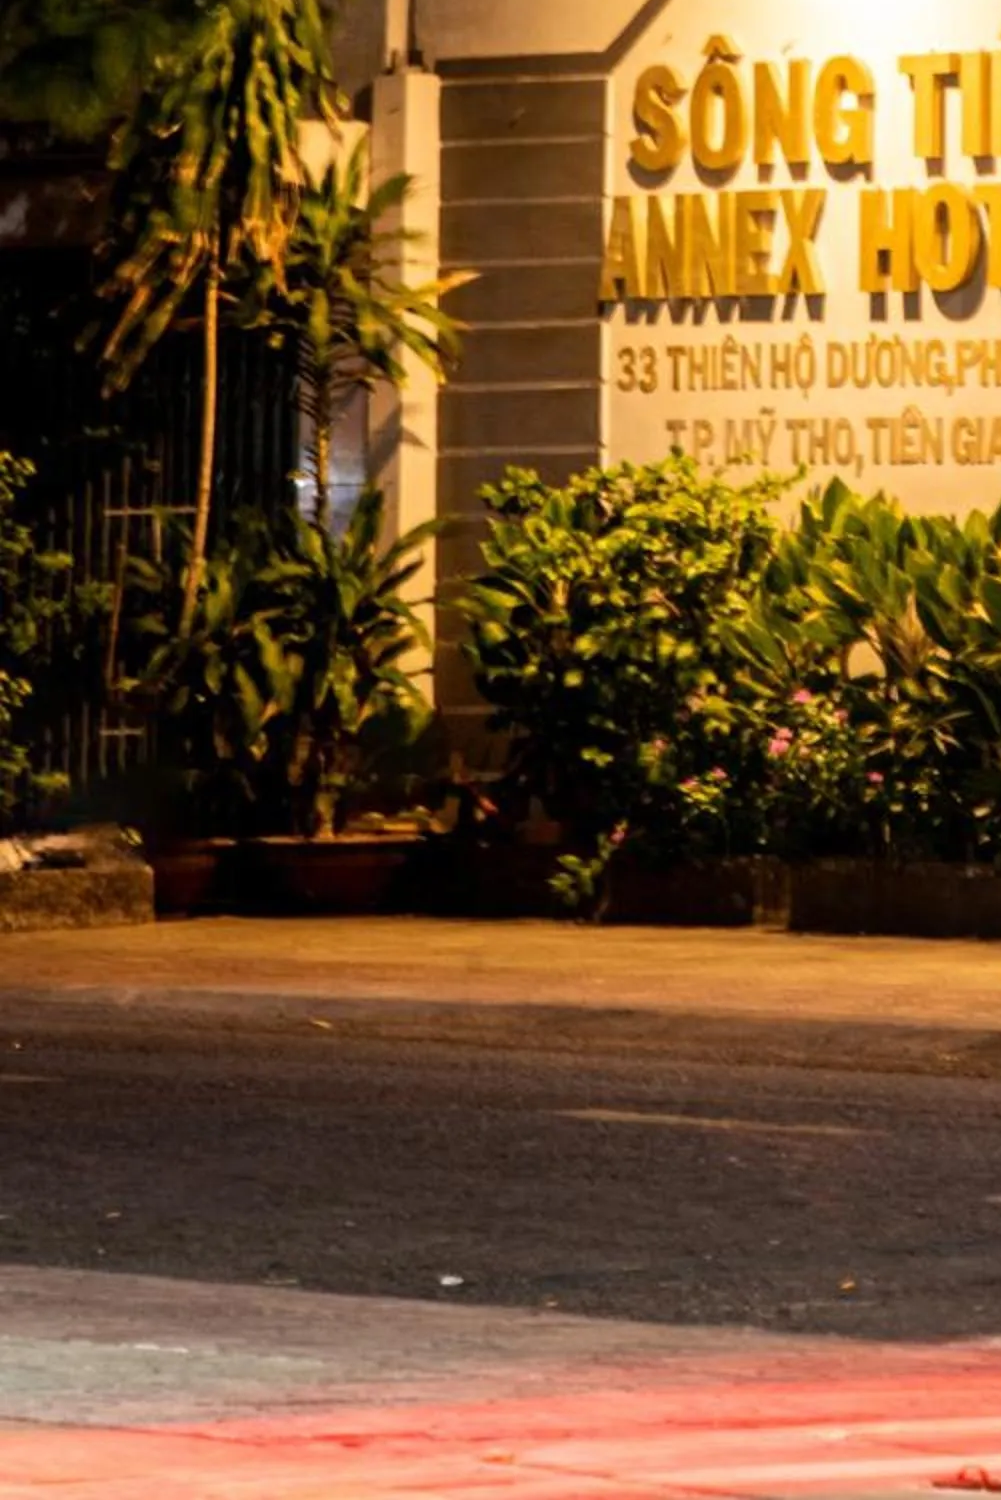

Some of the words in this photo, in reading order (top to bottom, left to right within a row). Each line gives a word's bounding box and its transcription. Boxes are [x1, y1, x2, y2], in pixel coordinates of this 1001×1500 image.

[629, 34, 876, 172] SÔNG
[603, 188, 827, 300] ANNEX
[616, 346, 658, 393] 33
[666, 334, 762, 391] THIÊN
[770, 332, 817, 399] HỘ
[724, 405, 777, 466] MỸ
